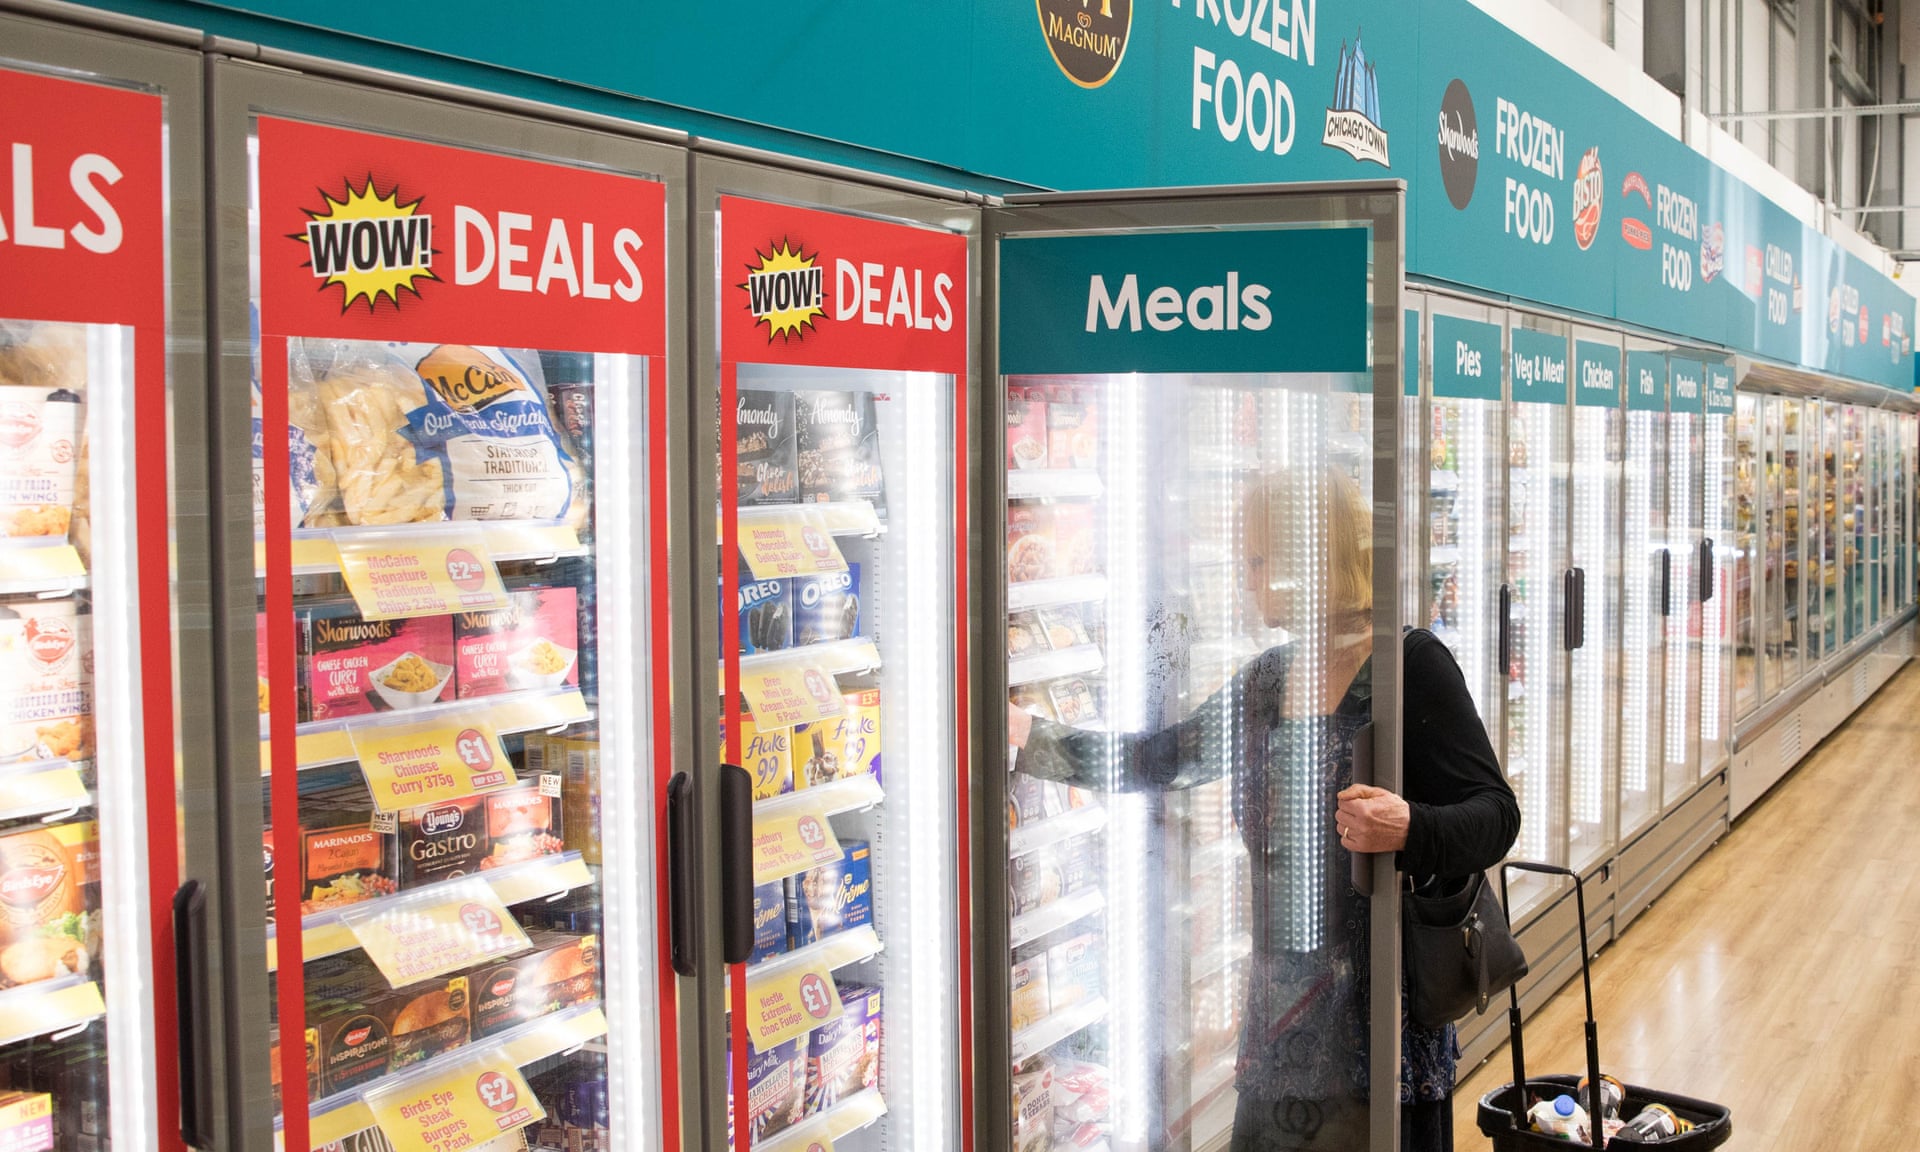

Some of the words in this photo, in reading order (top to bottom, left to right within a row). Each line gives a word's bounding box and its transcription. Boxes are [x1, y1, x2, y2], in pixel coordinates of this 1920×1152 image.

[1049, 12, 1116, 60] MAGNUM
[1192, 46, 1295, 155] FOOD
[1327, 115, 1363, 140] CHICAGO
[1364, 124, 1387, 160] TOWN
[1496, 96, 1564, 181] FROZEN
[0, 142, 124, 254] LS
[1505, 176, 1554, 244] FOOD
[1573, 170, 1601, 221] BISTO
[1657, 183, 1698, 241] FROZEN
[309, 216, 432, 276] WOW!
[455, 206, 643, 302] DEALS
[1662, 242, 1692, 291] FOOD
[750, 269, 822, 315] WOW!
[836, 258, 953, 332] DEALS
[1085, 271, 1273, 333] Meals
[1768, 288, 1788, 325] FOOD
[1456, 341, 1481, 377] Pies
[1515, 353, 1532, 387] Veg
[1535, 355, 1540, 381] &
[1542, 356, 1564, 384] Meat
[426, 363, 517, 404] McCain
[1583, 361, 1613, 390] Chicken
[1640, 369, 1654, 395] Fish
[1677, 374, 1697, 399] Potato
[424, 412, 456, 435] Our
[809, 397, 864, 436] Almondy
[803, 532, 828, 550] £2
[369, 570, 428, 586] Signature
[802, 573, 851, 606] OREO
[329, 670, 357, 687] CURRY
[59, 702, 91, 714] WINGS
[378, 743, 441, 765] Sharwoods
[458, 736, 491, 765] £1
[745, 733, 787, 759] flake
[393, 760, 440, 778] Chinese
[542, 776, 560, 785] NEW
[755, 755, 779, 788] 99
[391, 779, 424, 796] Curry
[424, 773, 455, 788] 375g
[426, 809, 461, 832] Young's
[800, 821, 824, 843] £2
[314, 833, 374, 849] MARINADES
[409, 832, 477, 861] Gastro
[463, 908, 500, 933] £2
[760, 991, 784, 1008] Nestle
[802, 980, 828, 1012] £1
[759, 1022, 780, 1037] Choc
[780, 1011, 803, 1029] Fudge
[761, 1003, 793, 1022] Extreme
[400, 1098, 432, 1119] Birds
[431, 1090, 455, 1106] Eye
[479, 1077, 516, 1107] £2
[20, 1099, 46, 1117] NEW
[418, 1106, 454, 1128] Steak
[421, 1118, 468, 1145] Burgers
[443, 1132, 474, 1152] Pack
